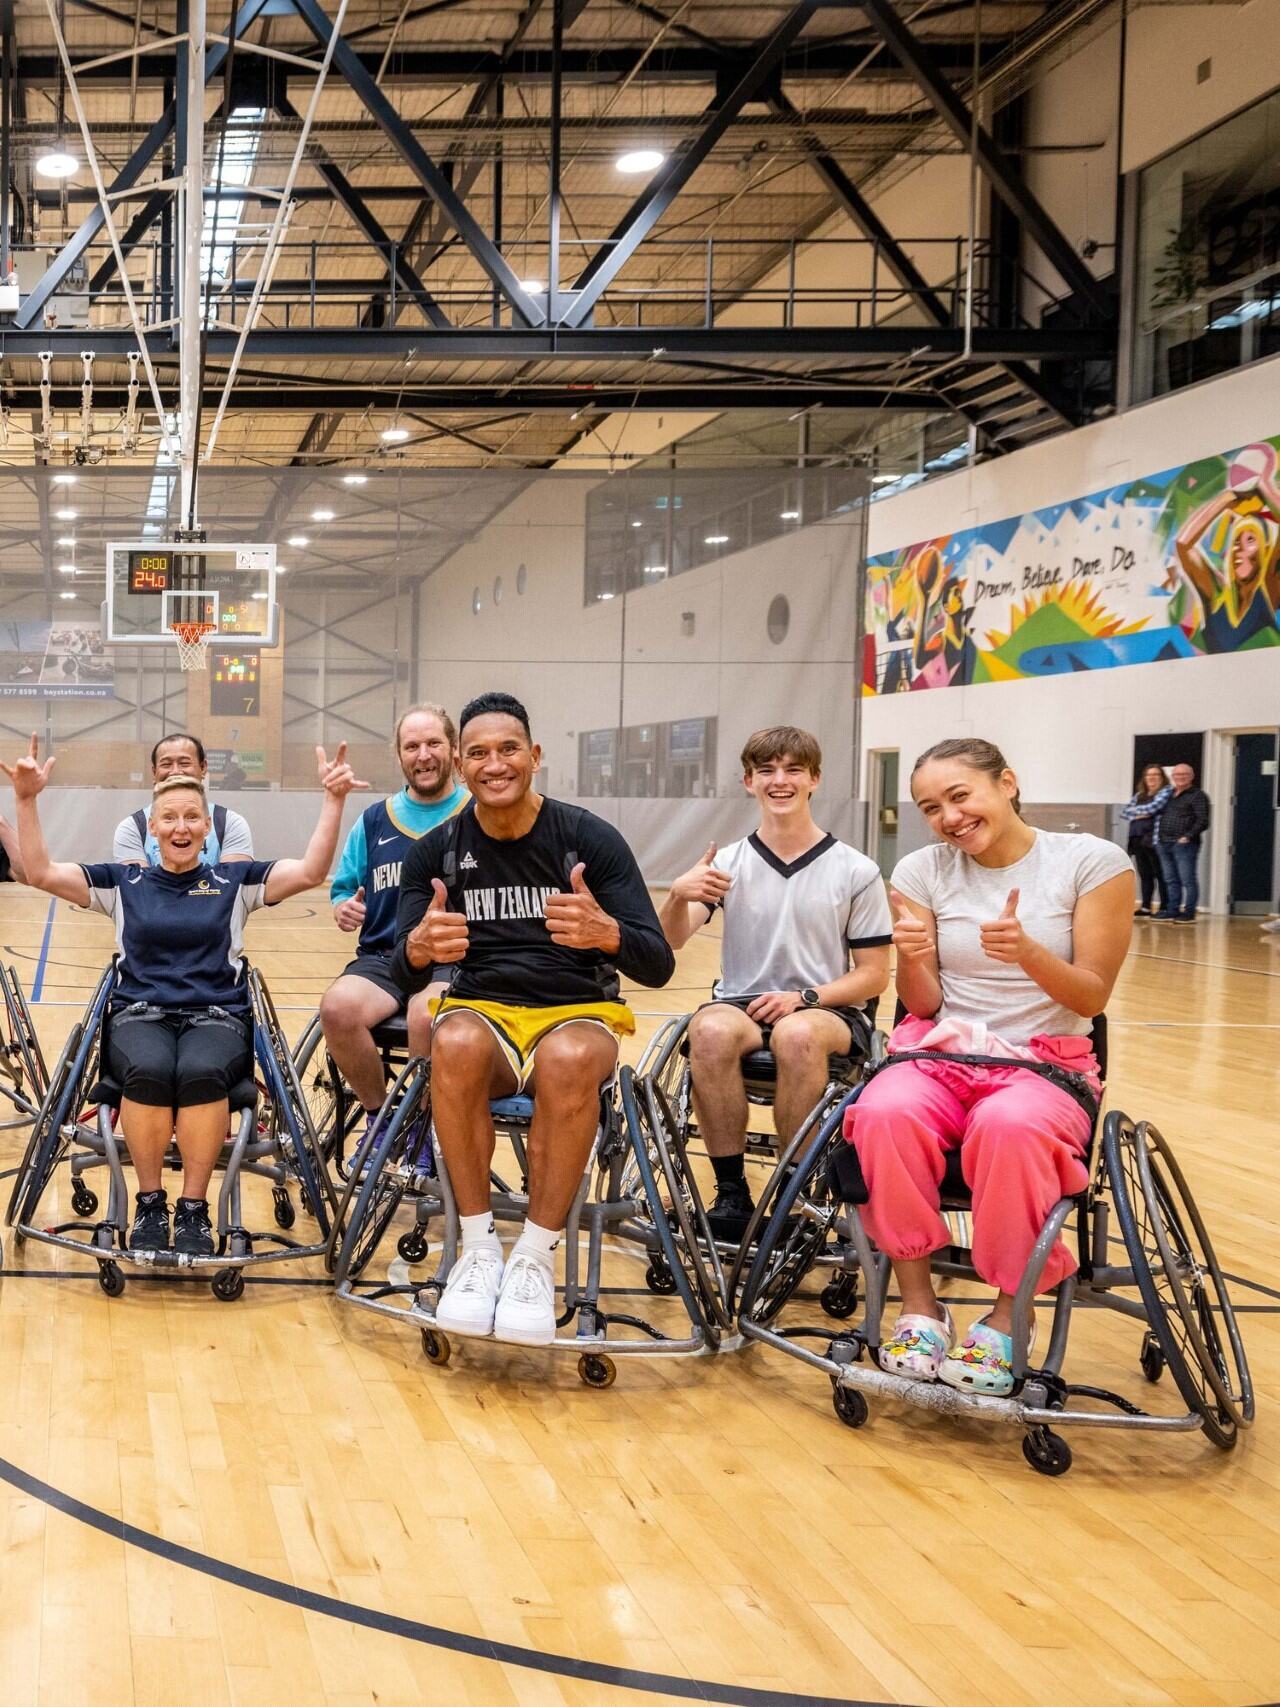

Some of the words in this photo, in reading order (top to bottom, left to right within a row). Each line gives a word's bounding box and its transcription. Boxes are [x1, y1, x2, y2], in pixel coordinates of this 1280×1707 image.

[141, 558, 167, 570] 0:00
[134, 571, 166, 588] 24.0
[43, 689, 107, 697] baystation.co.nz
[243, 697, 255, 713] 7
[373, 861, 403, 894] NEW
[463, 888, 496, 921] NEW
[498, 886, 561, 920] ZEALAN
